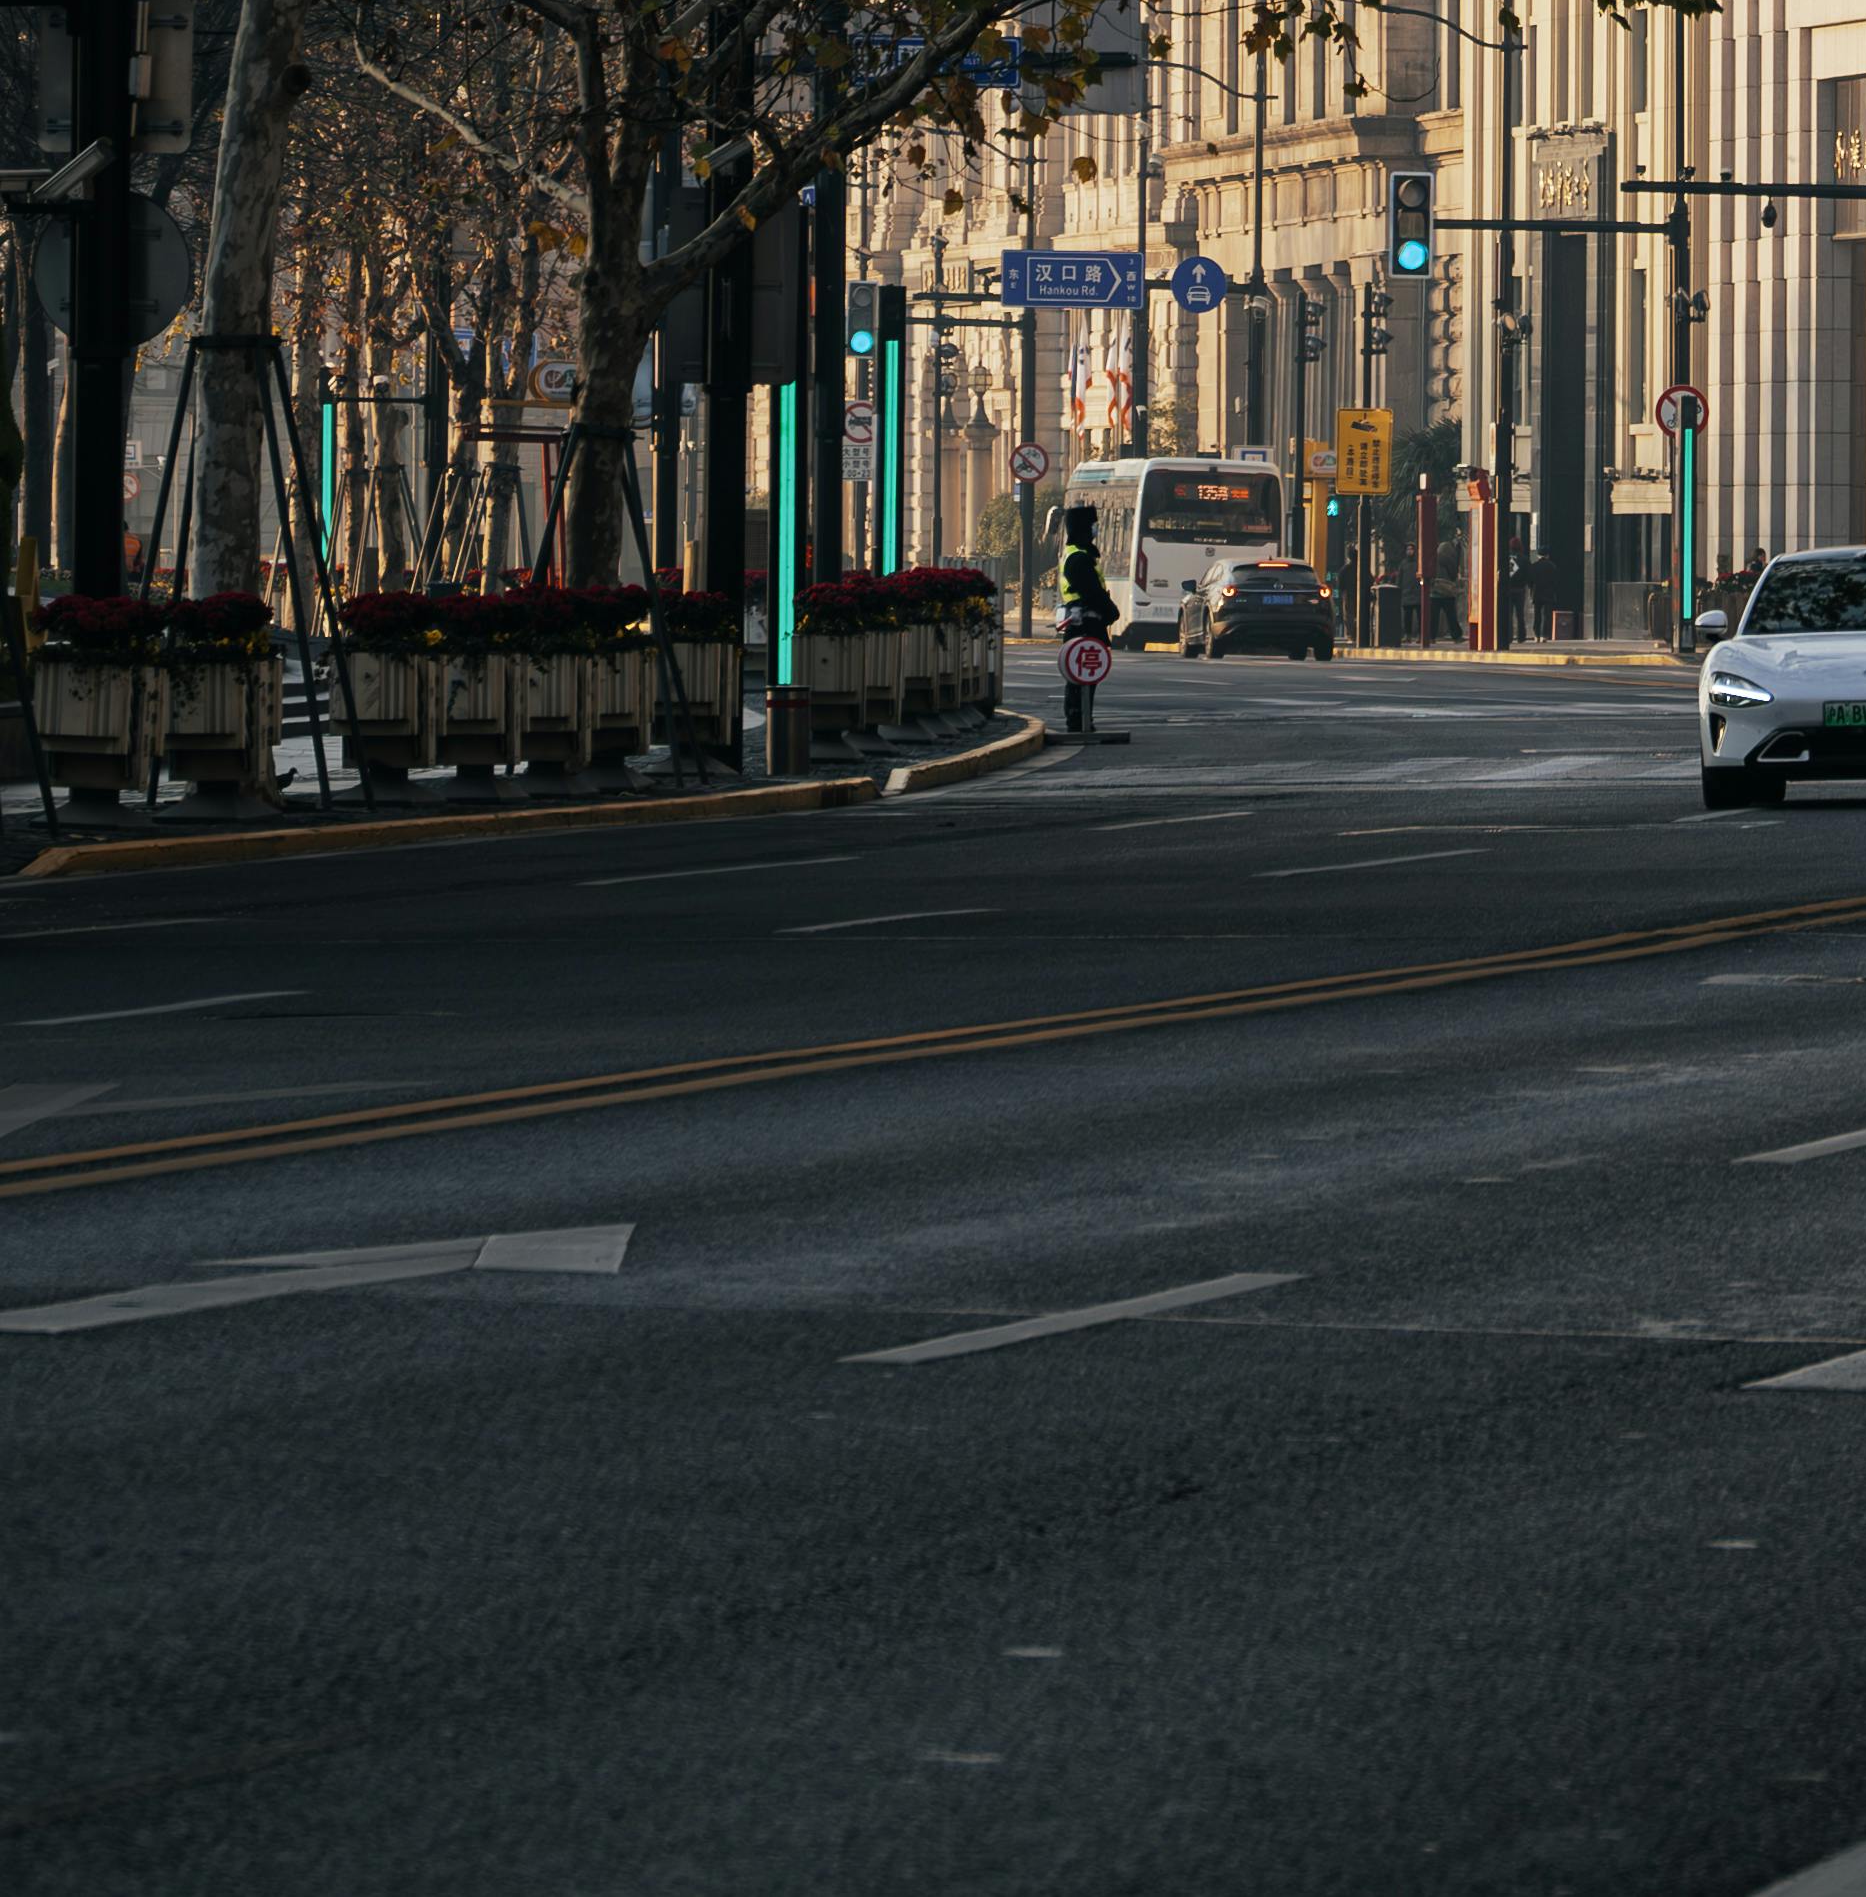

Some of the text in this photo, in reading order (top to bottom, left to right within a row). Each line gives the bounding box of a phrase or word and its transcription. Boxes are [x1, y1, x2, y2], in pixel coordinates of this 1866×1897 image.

[1008, 268, 1020, 281] 东
[1035, 263, 1103, 284] 汉口路
[1126, 270, 1137, 282] 西
[1039, 284, 1099, 296] Hankou Rd.
[1075, 645, 1102, 678] 停
